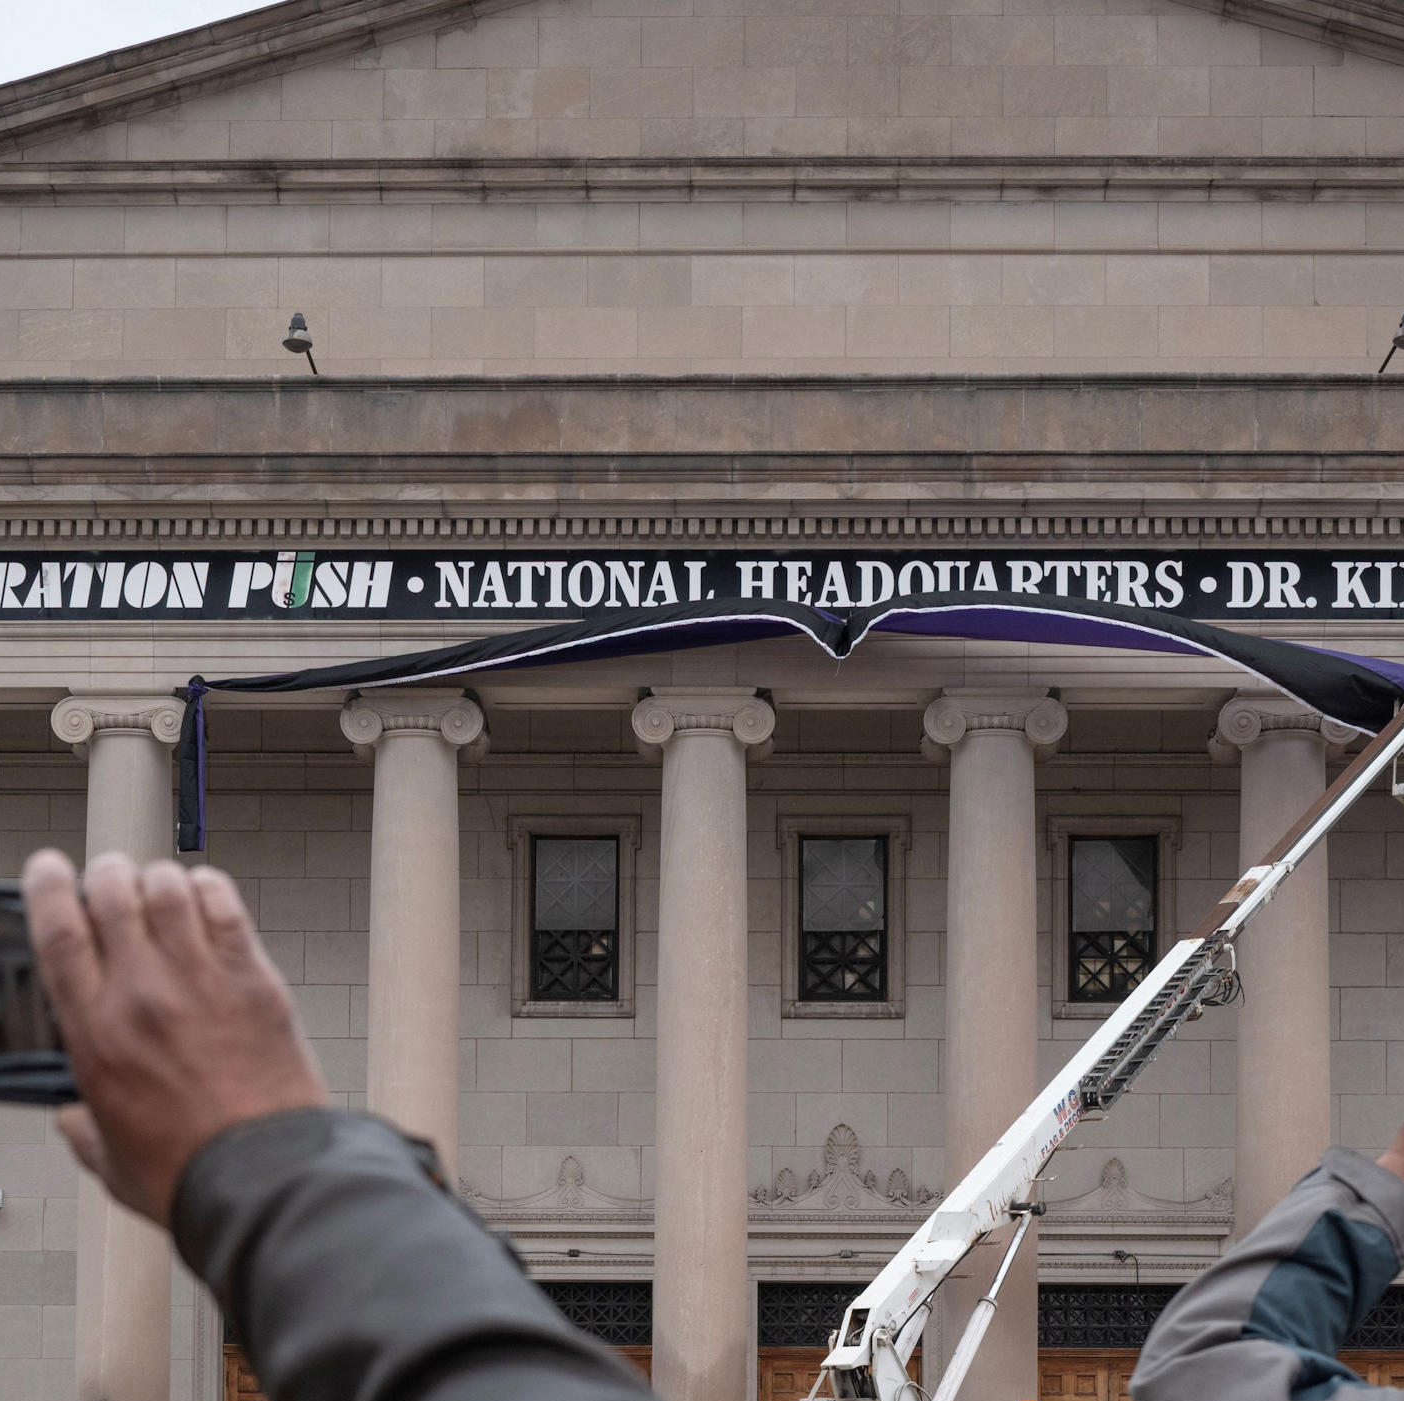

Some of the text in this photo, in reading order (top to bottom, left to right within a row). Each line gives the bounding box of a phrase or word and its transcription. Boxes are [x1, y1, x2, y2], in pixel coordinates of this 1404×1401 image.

[227, 551, 394, 609] PUSH
[434, 561, 715, 608] NATIONAL
[735, 561, 1184, 609] HEADQUARTERS
[1225, 561, 1318, 609] DR.
[1040, 1134, 1059, 1159] FLAG
